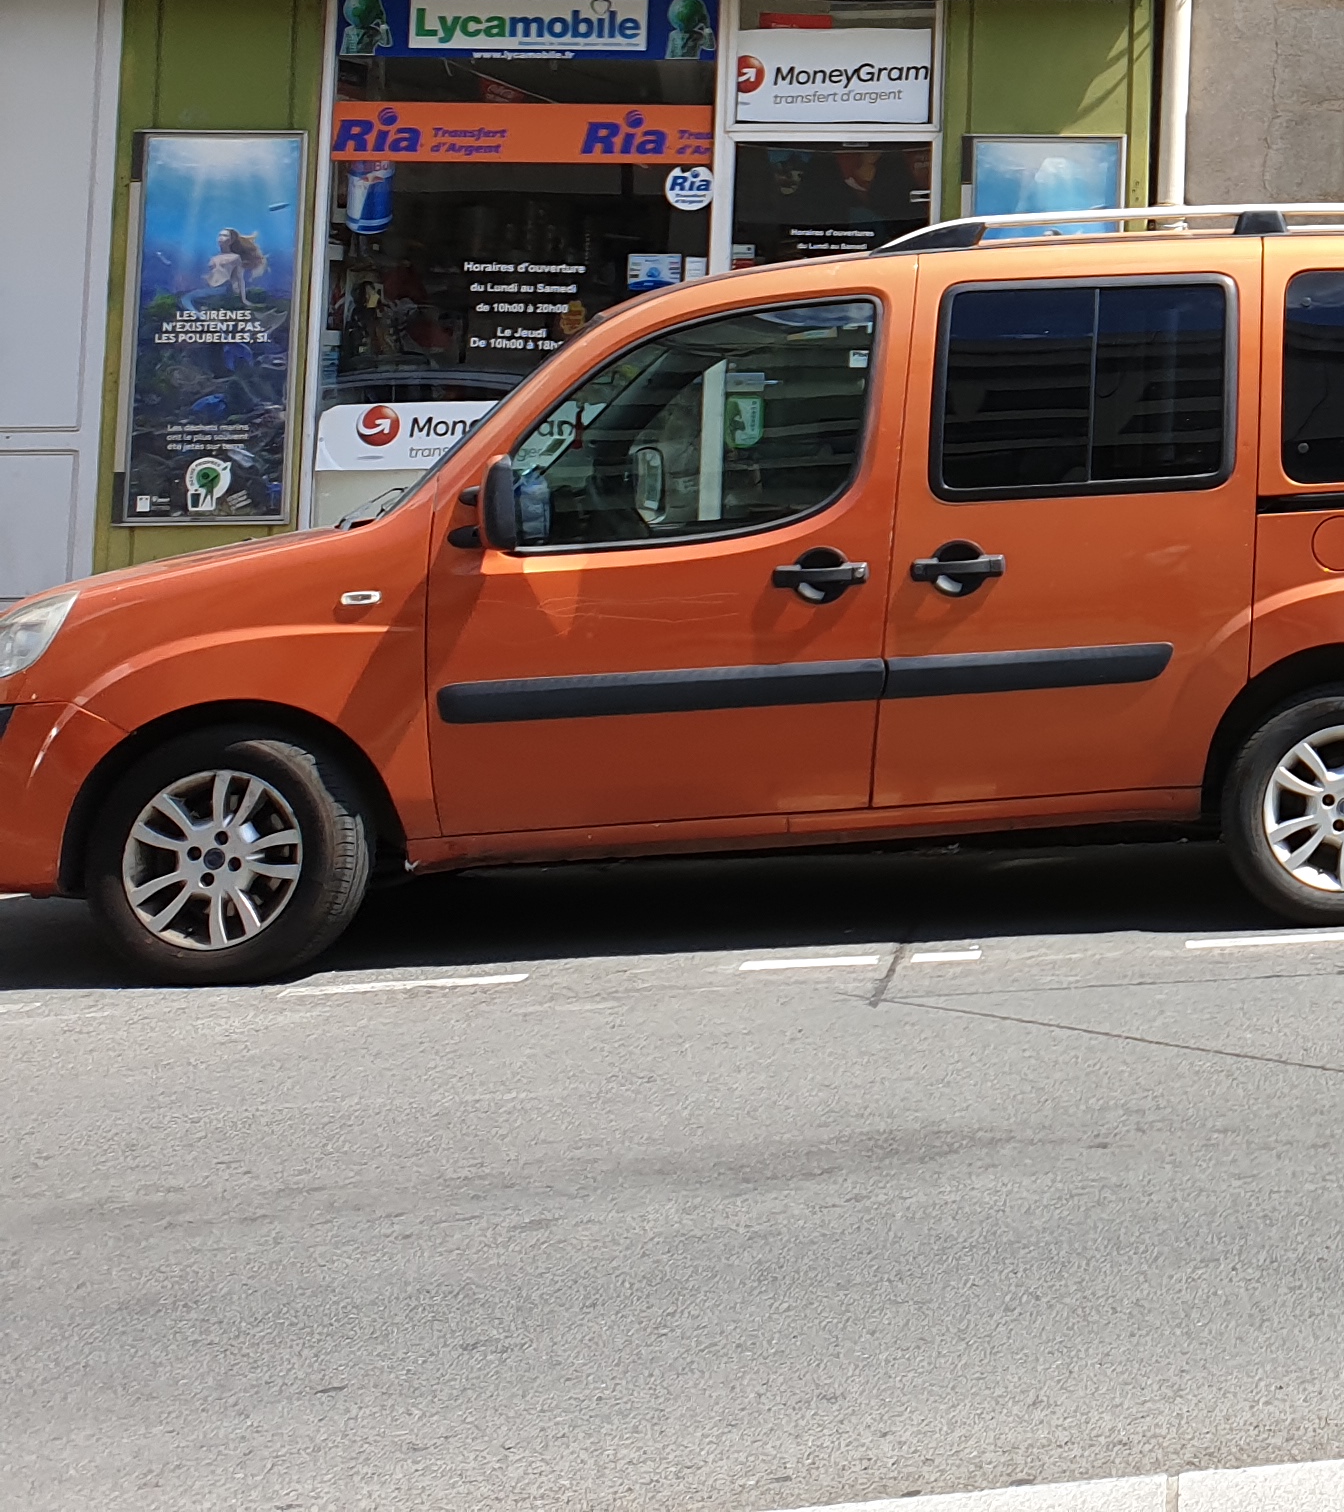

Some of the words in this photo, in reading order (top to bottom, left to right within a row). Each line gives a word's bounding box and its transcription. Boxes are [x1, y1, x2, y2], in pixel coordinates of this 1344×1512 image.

[414, 0, 641, 44] Lycamobile
[773, 62, 929, 88] MoneyGram
[773, 90, 838, 105] transfert
[841, 89, 903, 104] d'argent
[332, 107, 421, 153] Ria
[432, 127, 508, 141] Transfert
[581, 109, 668, 155] Ria
[430, 142, 502, 156] d'Argent
[669, 170, 711, 192] Ria
[463, 261, 515, 273] Horaires
[517, 262, 587, 273] d'ouverture
[470, 283, 485, 292] du
[487, 283, 518, 292] Lundi
[536, 284, 577, 293] Samedi
[176, 310, 197, 320] LES
[200, 309, 252, 320] SIRÈNES
[162, 321, 237, 331] N'EXISTENT
[237, 321, 265, 331] PAS.
[497, 327, 512, 337] Le
[514, 327, 547, 338] Jeudi
[155, 333, 176, 343] LES
[178, 333, 254, 343] POUBELLES,
[256, 333, 271, 343] SI.
[470, 338, 487, 348] De
